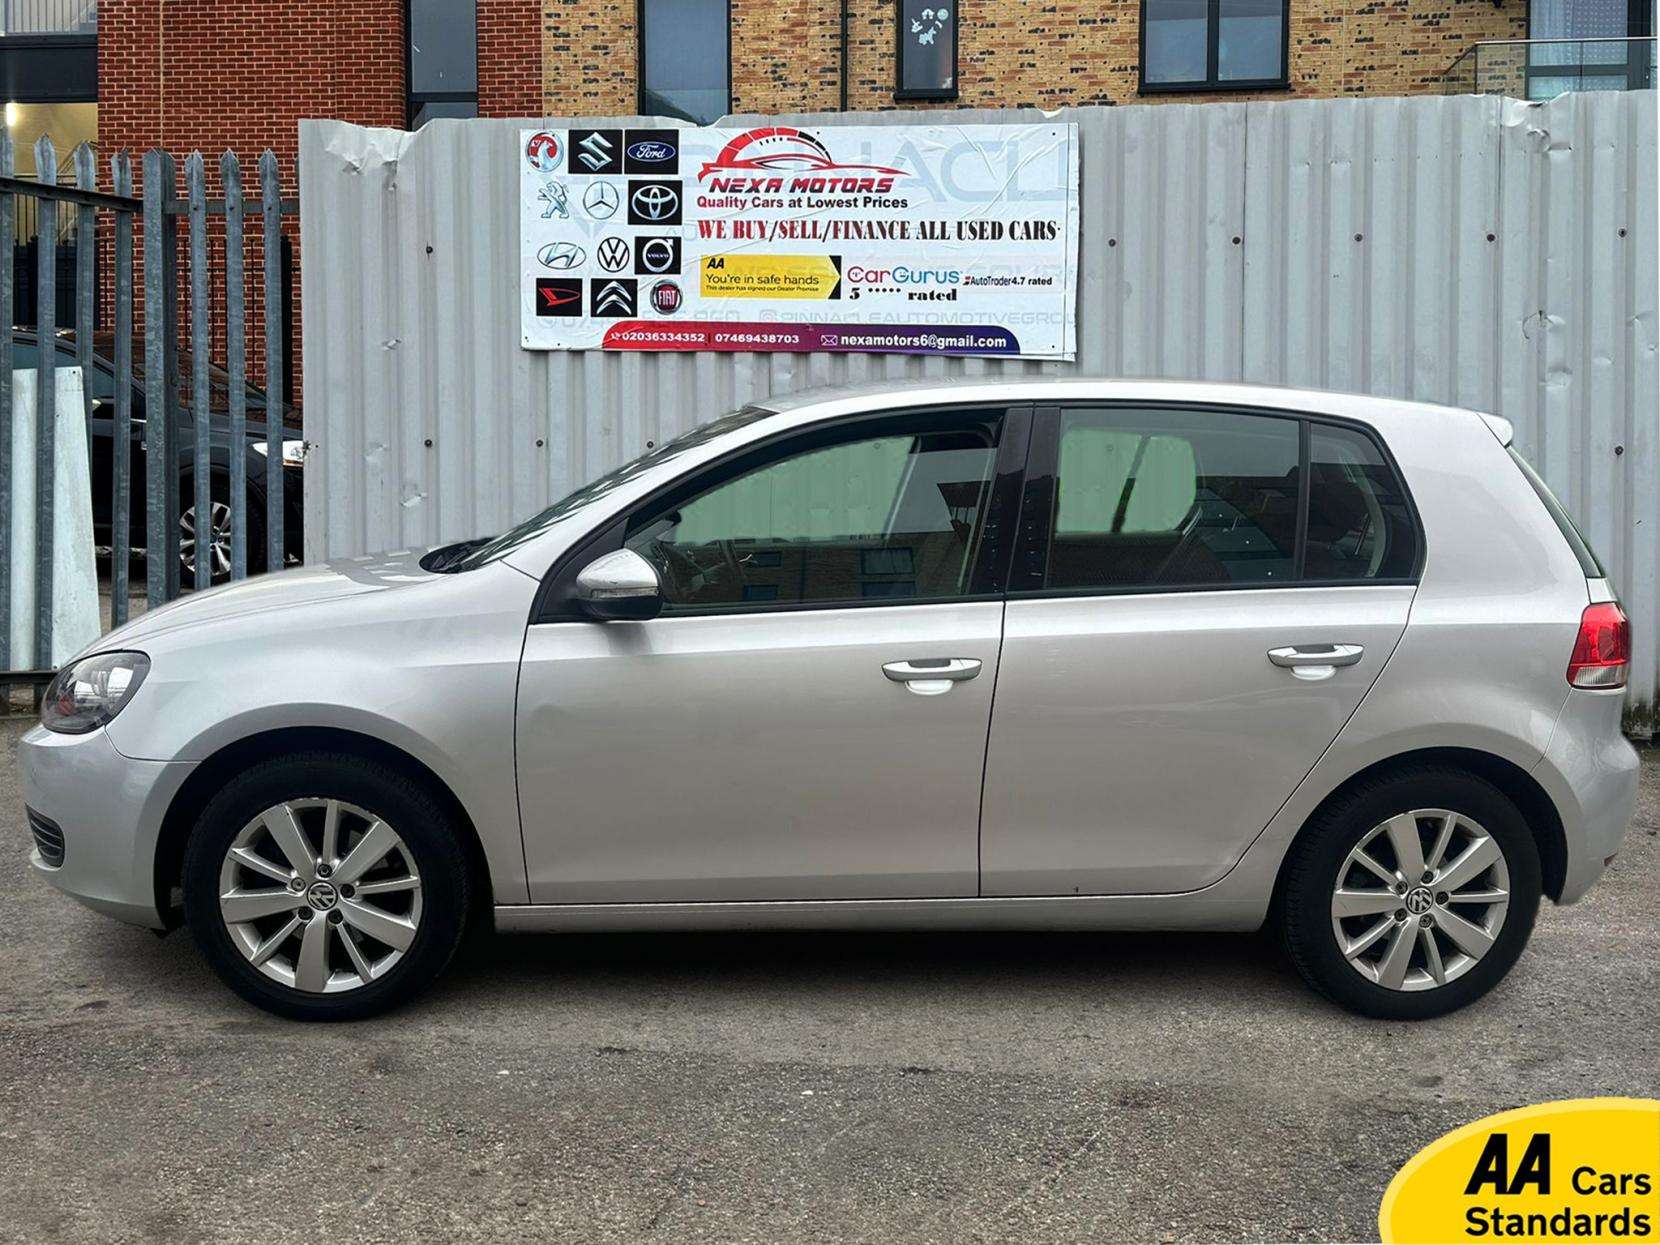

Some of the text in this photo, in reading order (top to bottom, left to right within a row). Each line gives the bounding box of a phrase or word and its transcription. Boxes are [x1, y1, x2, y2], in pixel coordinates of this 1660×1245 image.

[636, 144, 666, 159] Ford
[709, 178, 894, 194] NEXA MOTORS
[697, 196, 908, 210] Quality Cars at Lowest Prices
[698, 220, 727, 240] WE
[732, 219, 911, 243] BUY/SELL/FINANCE
[916, 220, 951, 240] ALL
[957, 220, 1004, 240] USED
[1009, 220, 1057, 240] CARS
[706, 257, 725, 269] AA
[705, 273, 820, 285] You're in safe hands
[847, 266, 960, 284] CarGurus
[1028, 277, 1053, 286] rated
[658, 289, 677, 306] FIAT
[849, 287, 957, 301] 5 rated
[622, 332, 1007, 348] 02036334352 07469438703 nexamotors6@gmail.com
